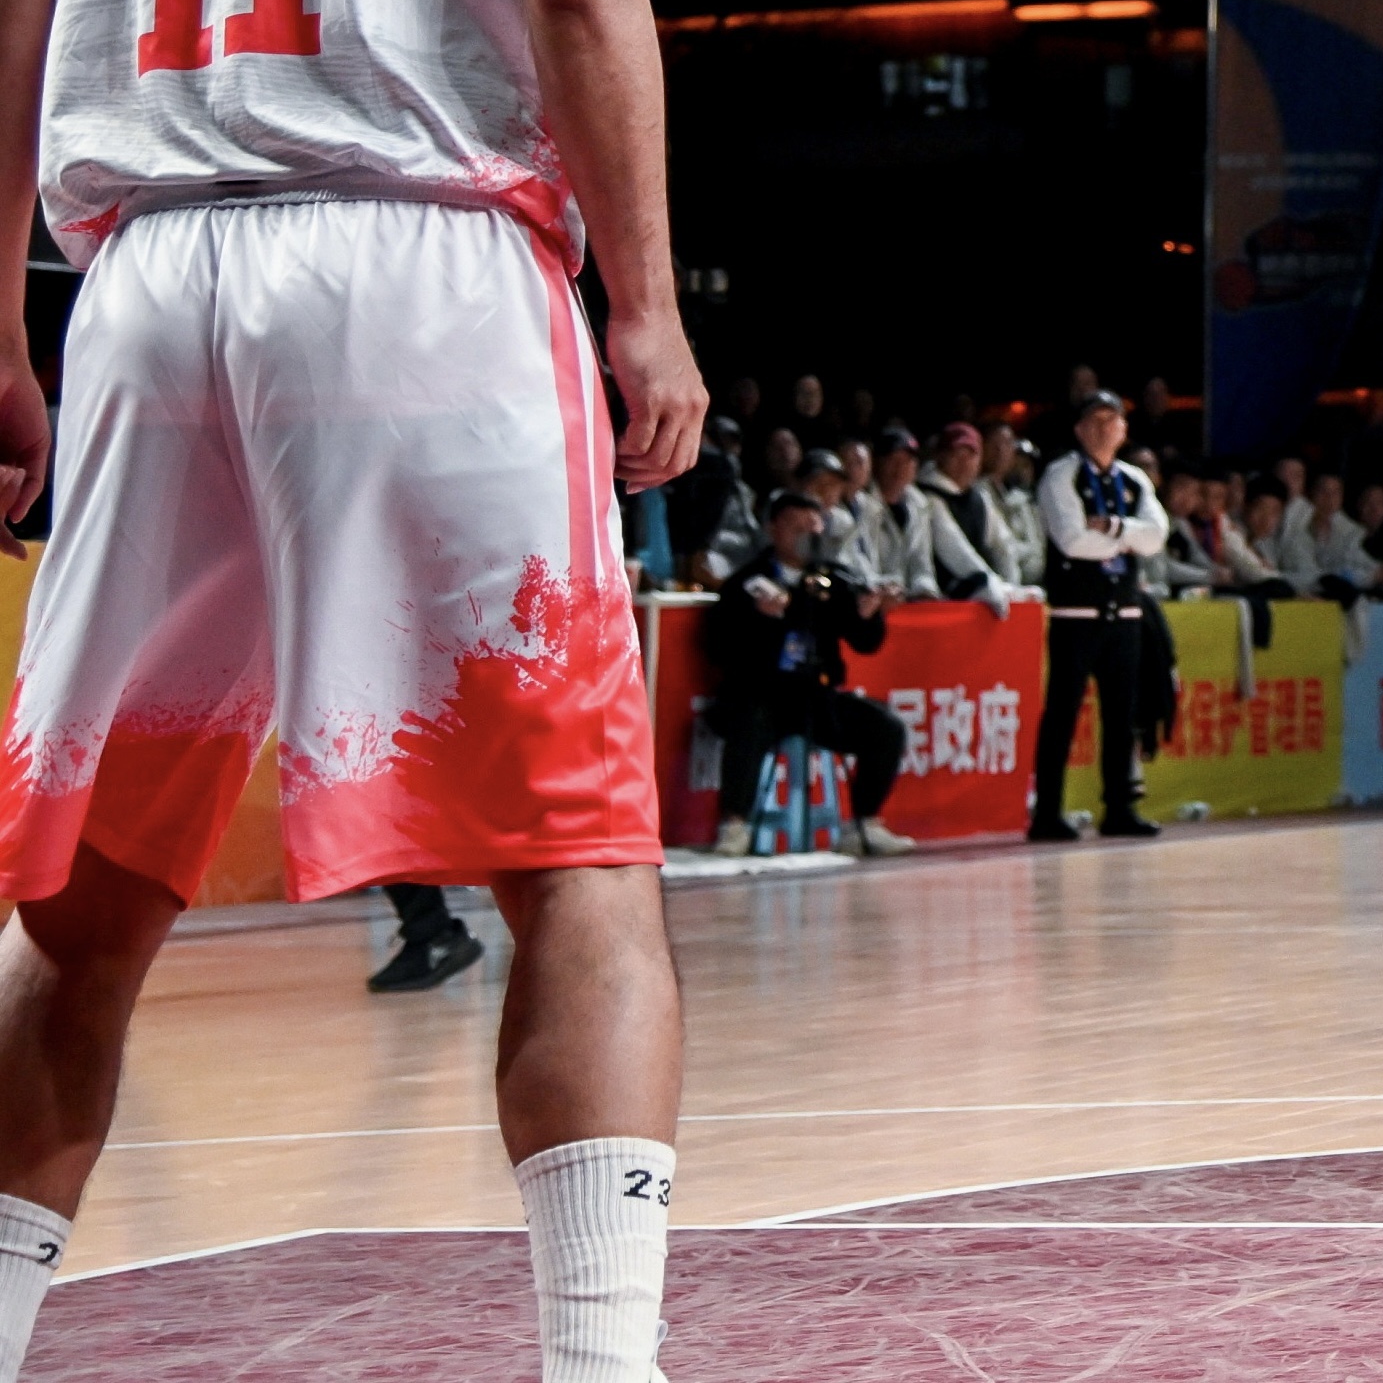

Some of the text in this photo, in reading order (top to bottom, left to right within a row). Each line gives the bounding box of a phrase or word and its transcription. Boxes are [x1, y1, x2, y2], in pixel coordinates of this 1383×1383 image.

[852, 682, 1020, 777] 民政府
[1166, 676, 1326, 760] 保护管理局
[623, 1169, 671, 1207] 23
